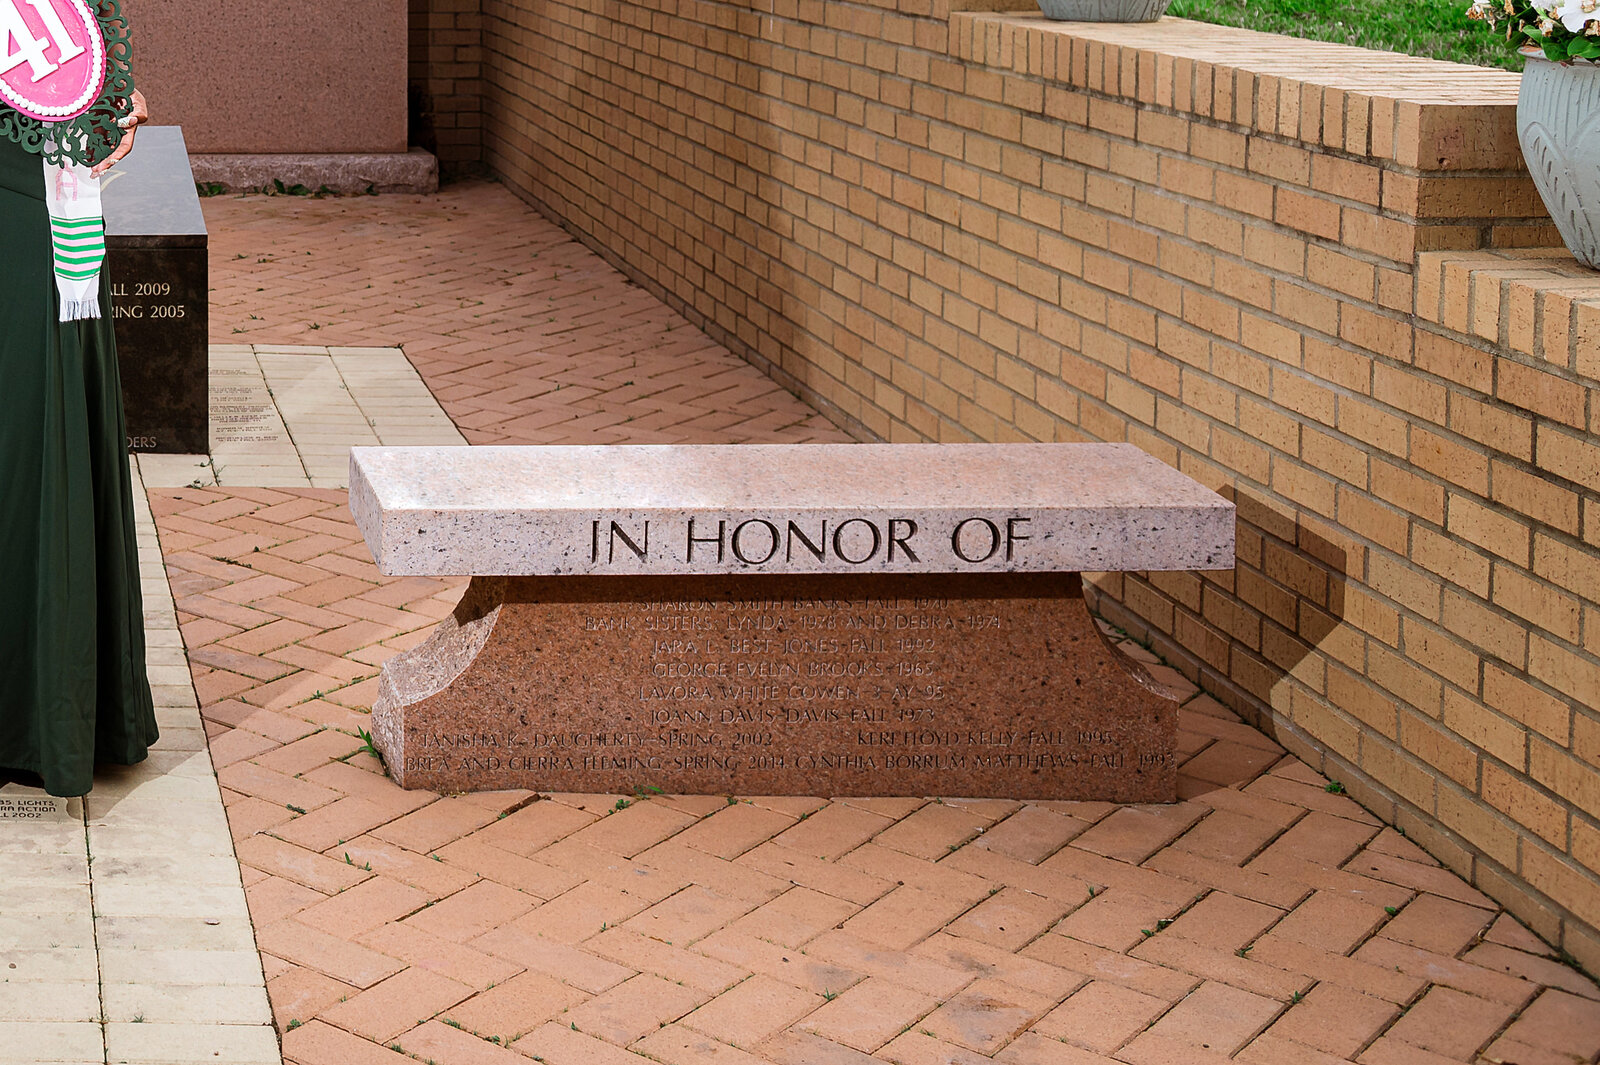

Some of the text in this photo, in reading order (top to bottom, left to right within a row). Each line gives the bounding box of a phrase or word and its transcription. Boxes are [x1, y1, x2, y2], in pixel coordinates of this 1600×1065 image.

[135, 282, 170, 296] 2009
[150, 305, 185, 318] 2005
[590, 517, 1032, 565] IN HONOR OF
[640, 597, 718, 612] SHARON
[726, 597, 785, 612] SMITH
[584, 616, 635, 631] BANK
[846, 615, 887, 630] AND
[897, 638, 936, 653] 1992
[652, 663, 727, 678] GEORGE
[736, 663, 801, 678] EVELYN
[639, 686, 715, 701] LAVORA
[721, 686, 780, 701] WHITE
[650, 709, 712, 724] JOANN
[898, 708, 936, 723] 1973
[734, 732, 773, 747] 2002
[405, 757, 450, 771] BREA
[459, 756, 501, 771] AND
[795, 755, 877, 770] CYNTHIA
[885, 754, 966, 770] BORRUM
